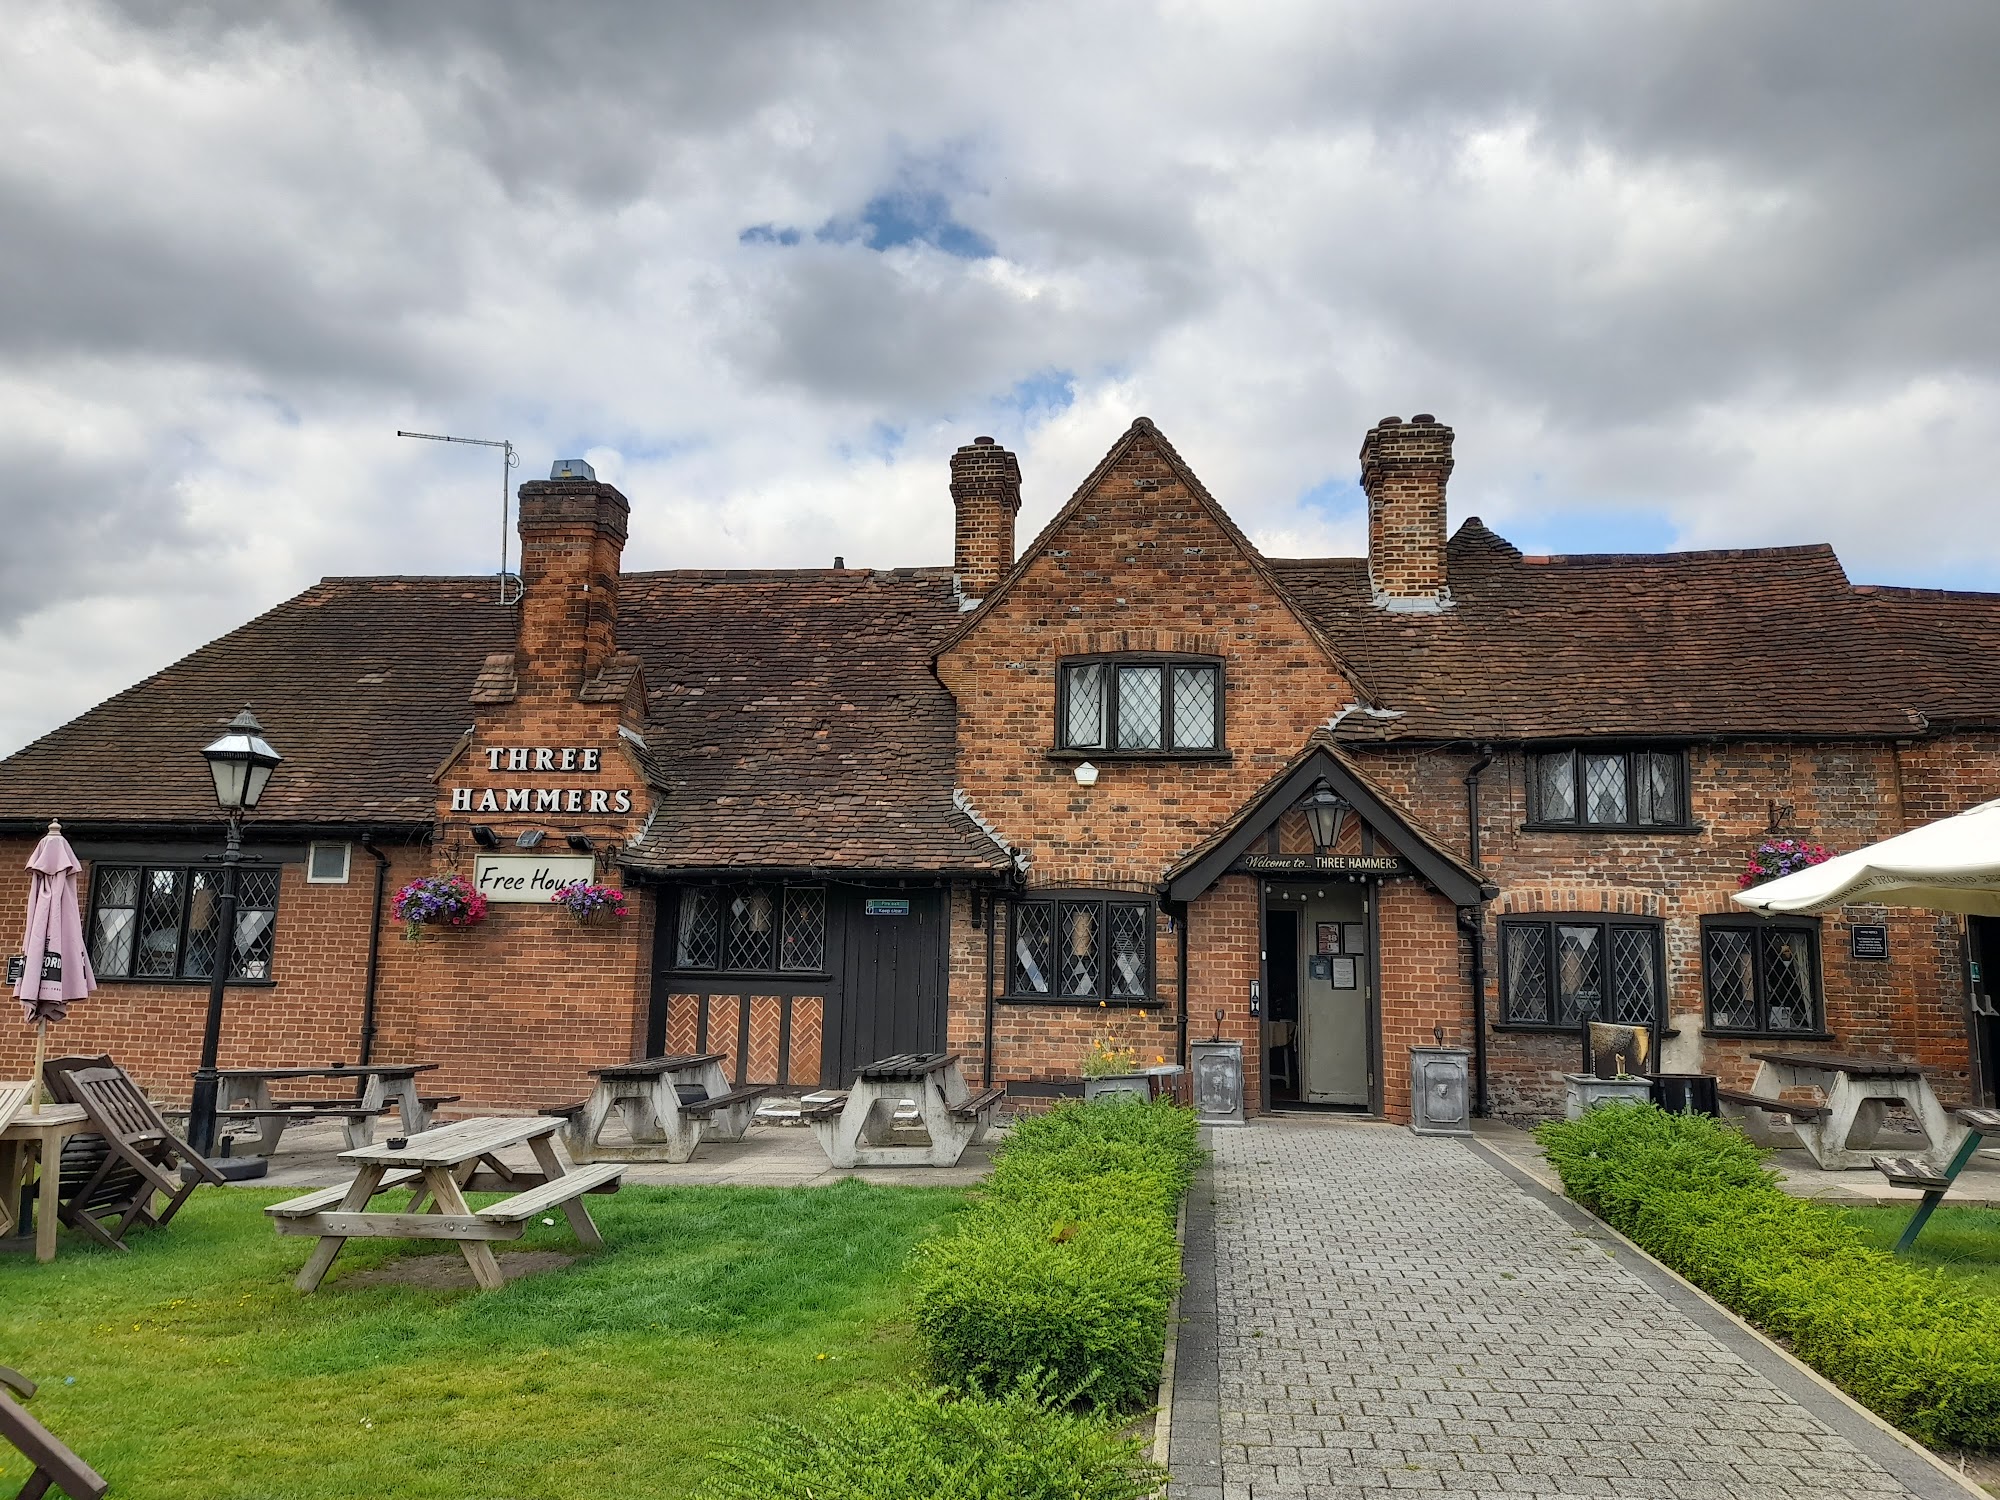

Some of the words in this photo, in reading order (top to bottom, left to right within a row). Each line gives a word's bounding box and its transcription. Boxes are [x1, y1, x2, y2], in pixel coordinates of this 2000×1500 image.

[485, 747, 601, 772] THREE
[450, 788, 632, 813] HAMMERS
[1245, 855, 1291, 868] Welcome
[1315, 856, 1345, 869] THREE
[1348, 857, 1398, 869] HAMMERS
[480, 867, 525, 890] Free
